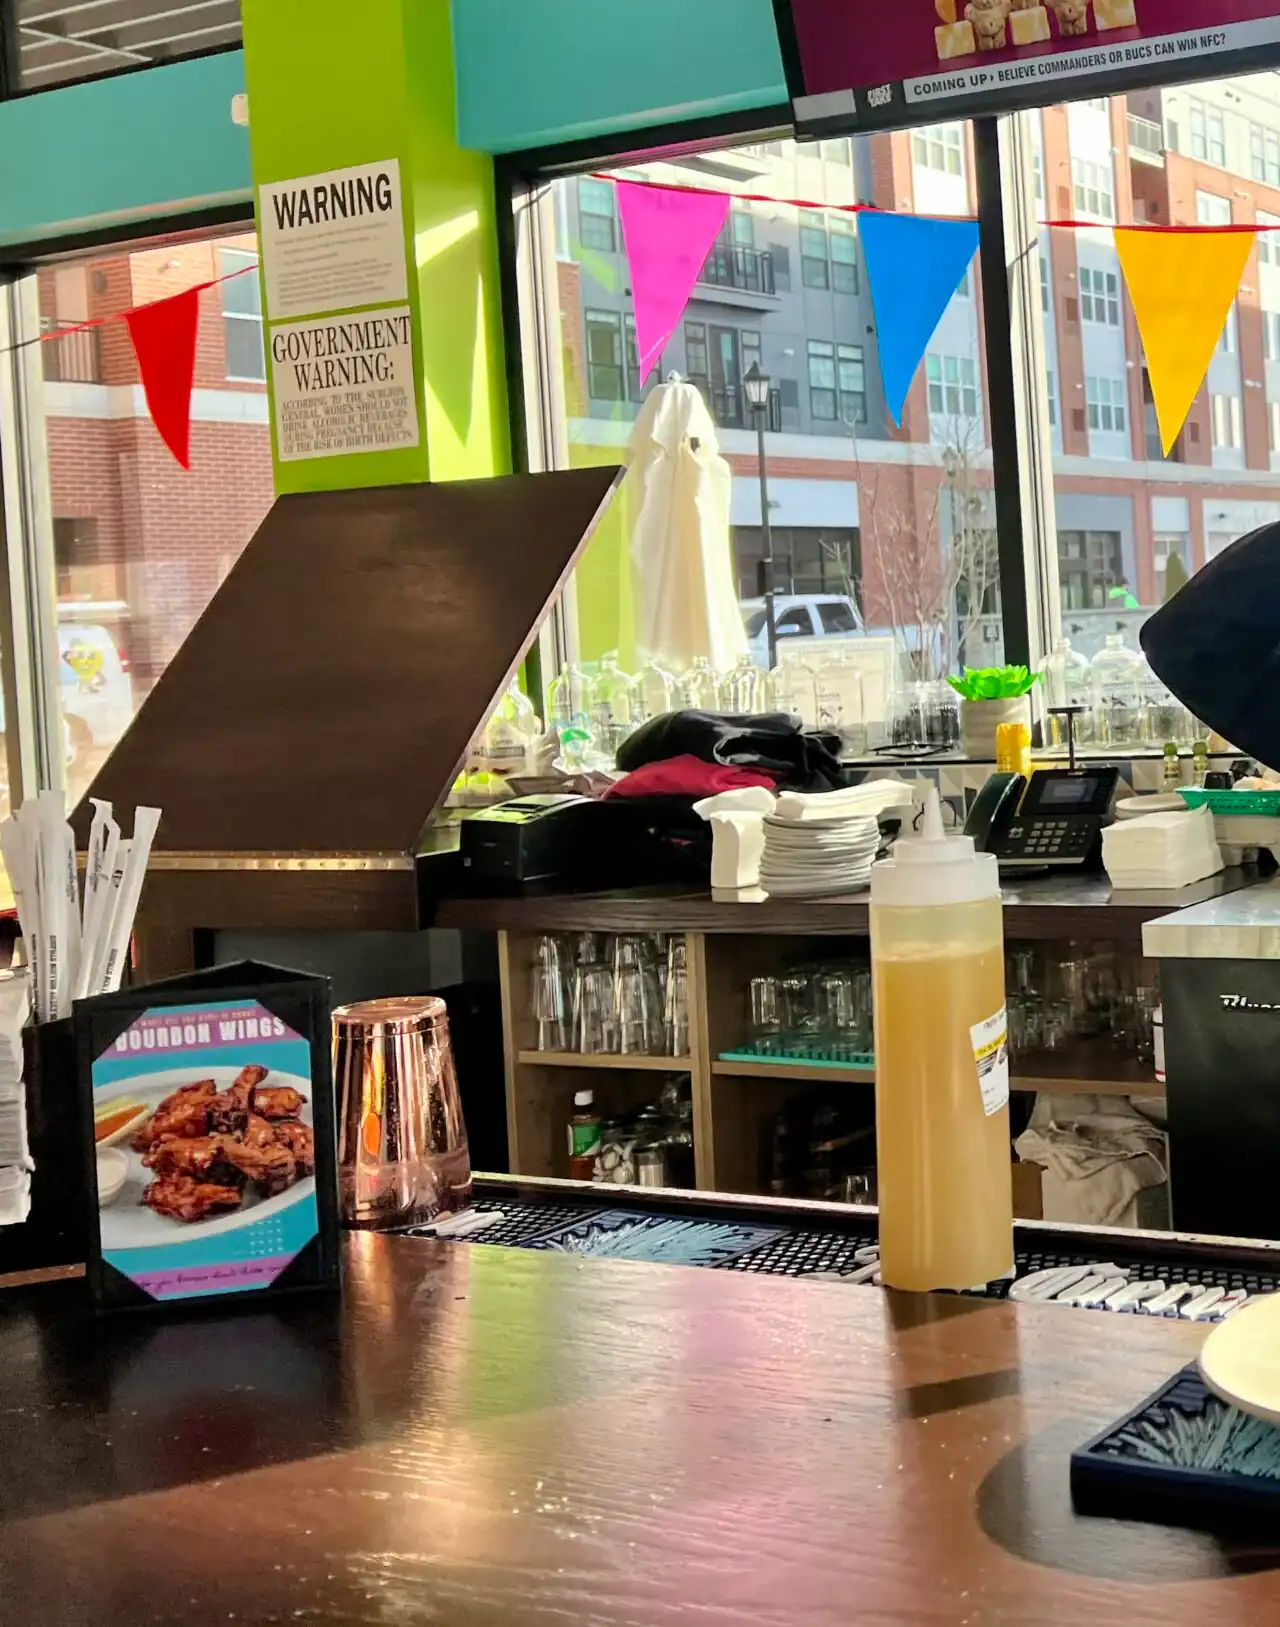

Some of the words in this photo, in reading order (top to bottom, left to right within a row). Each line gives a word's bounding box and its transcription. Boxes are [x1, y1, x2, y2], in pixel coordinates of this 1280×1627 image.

[914, 77, 966, 96] COMING
[970, 74, 987, 87] UP
[998, 64, 1036, 82] BELIEVE
[1038, 53, 1106, 76] COMMANDERS
[1109, 50, 1124, 64] OR
[1126, 46, 1152, 61] BUCS
[1155, 42, 1175, 56] CAN
[1177, 38, 1197, 52] WIN
[1200, 33, 1226, 48] NFC?
[272, 173, 392, 230] WARNING
[273, 316, 410, 363] GOVERNMENT
[294, 352, 394, 392] WARNING:
[345, 392, 361, 402] THE
[217, 1016, 286, 1041] WINGS
